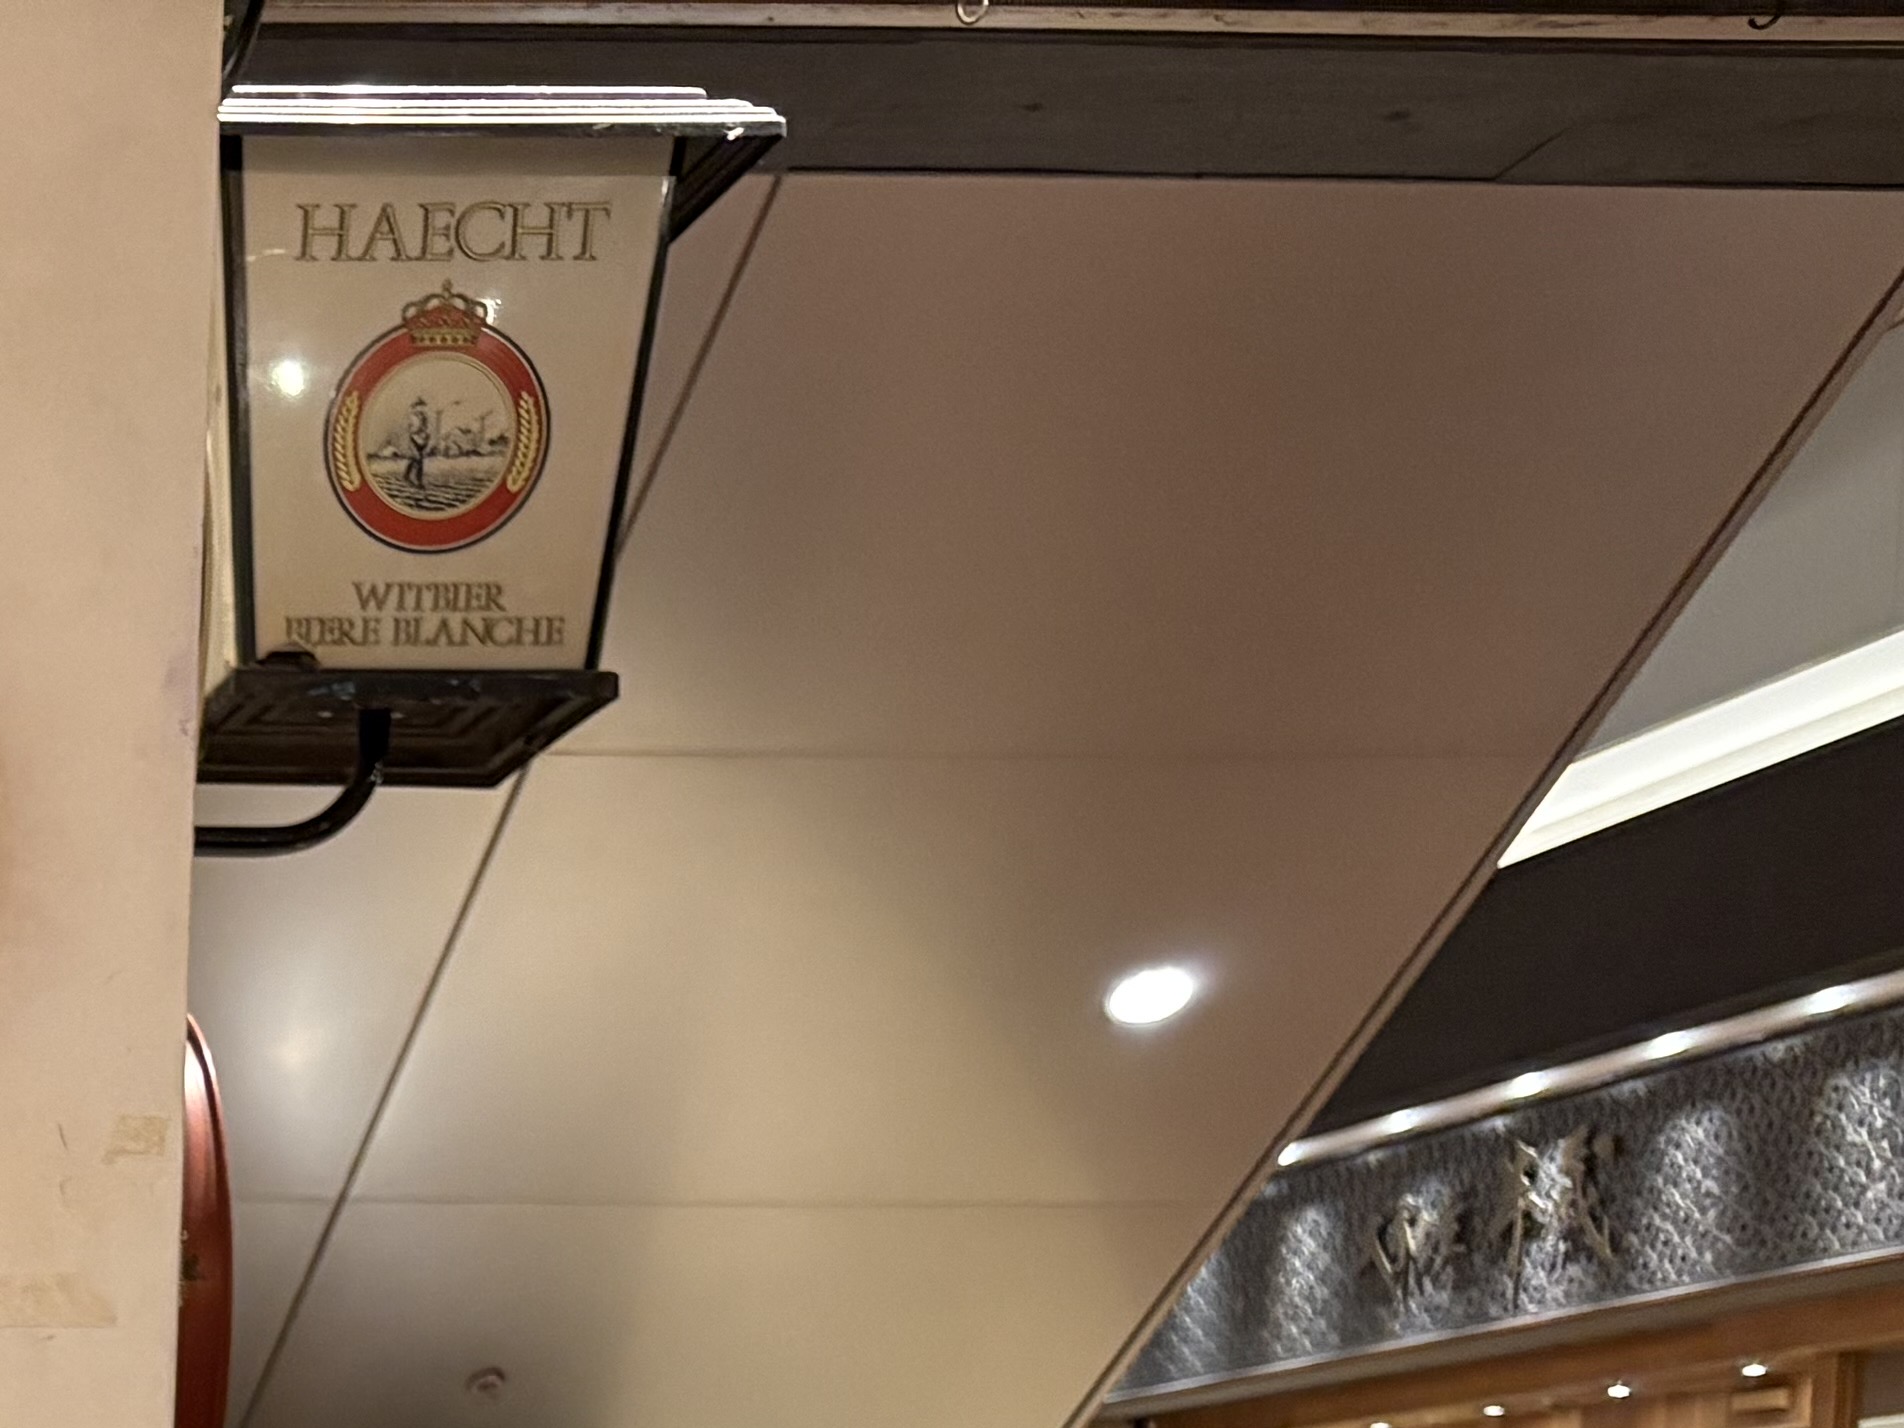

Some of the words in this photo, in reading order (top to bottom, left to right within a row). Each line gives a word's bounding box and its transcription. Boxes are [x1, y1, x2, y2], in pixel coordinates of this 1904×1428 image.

[295, 200, 612, 262] HAECHT
[351, 580, 506, 613] WITBIER
[392, 616, 566, 647] BLANCHE
